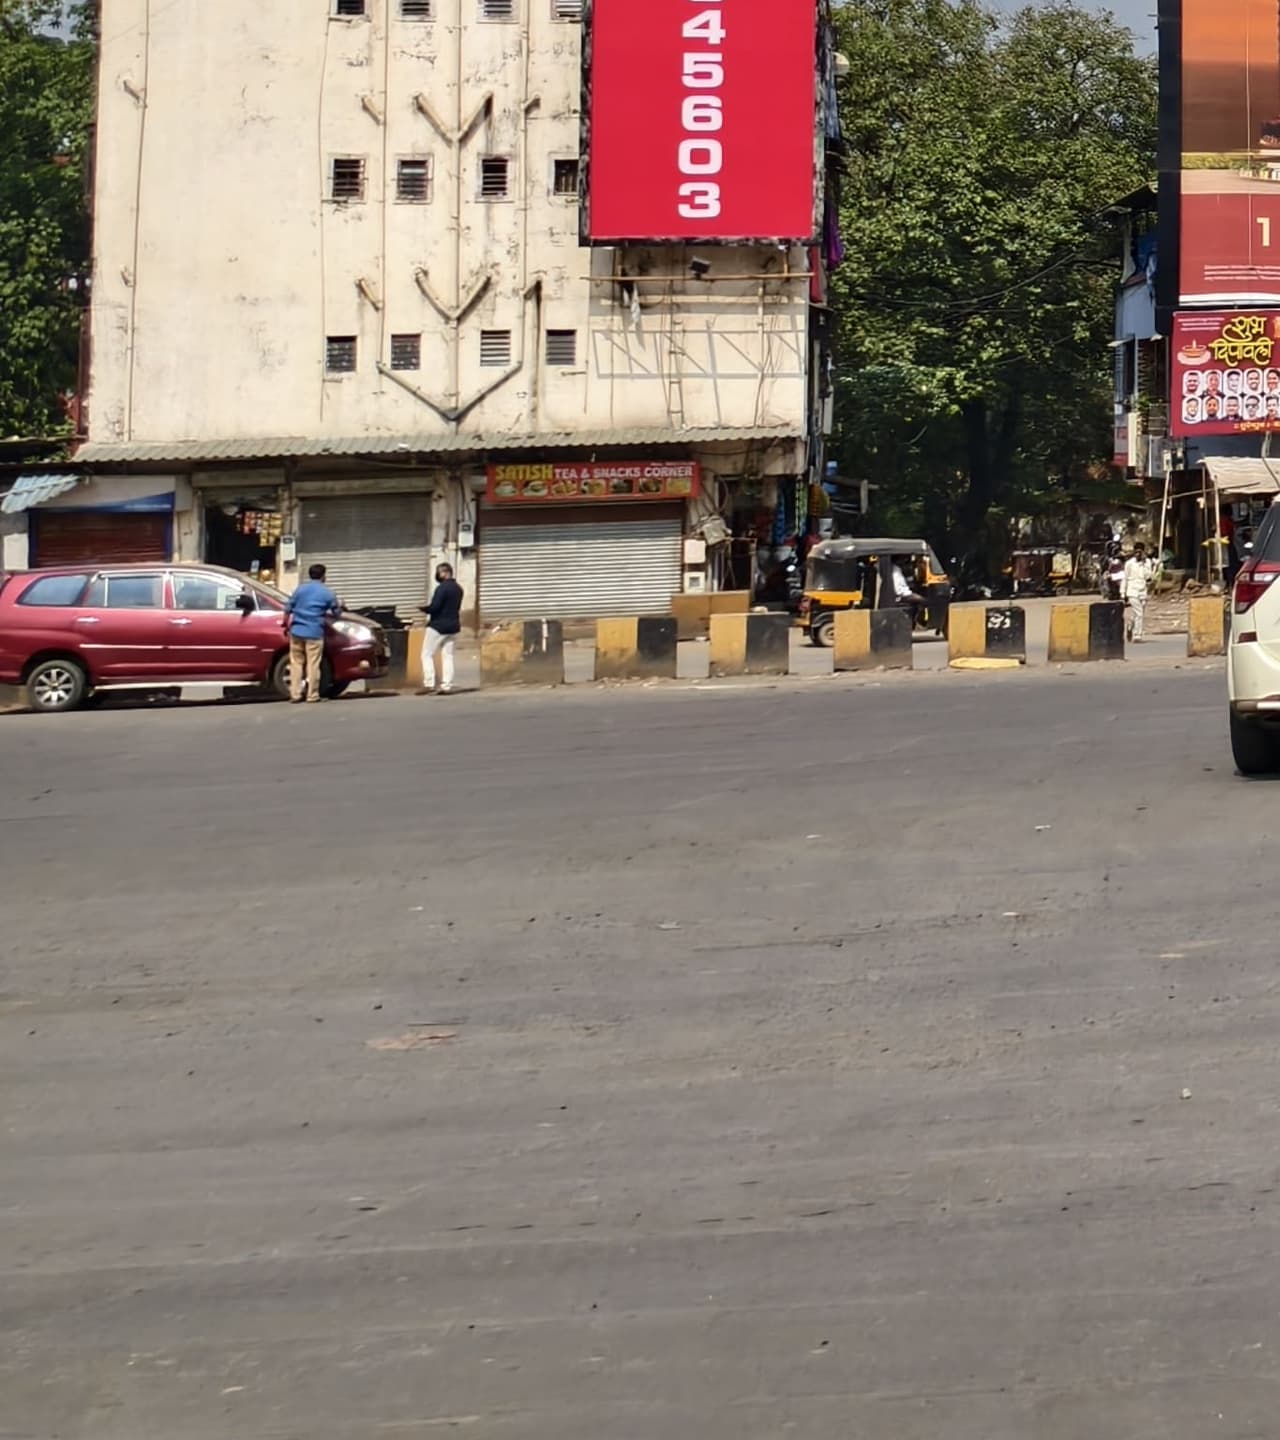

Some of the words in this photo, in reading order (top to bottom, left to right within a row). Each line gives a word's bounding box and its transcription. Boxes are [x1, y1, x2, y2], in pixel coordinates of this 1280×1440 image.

[1256, 216, 1271, 247] 1
[495, 464, 553, 481] SATISH
[554, 467, 578, 479] TEA
[580, 467, 590, 479] &
[593, 466, 642, 479] SNACKS
[643, 465, 693, 478] CORNER
